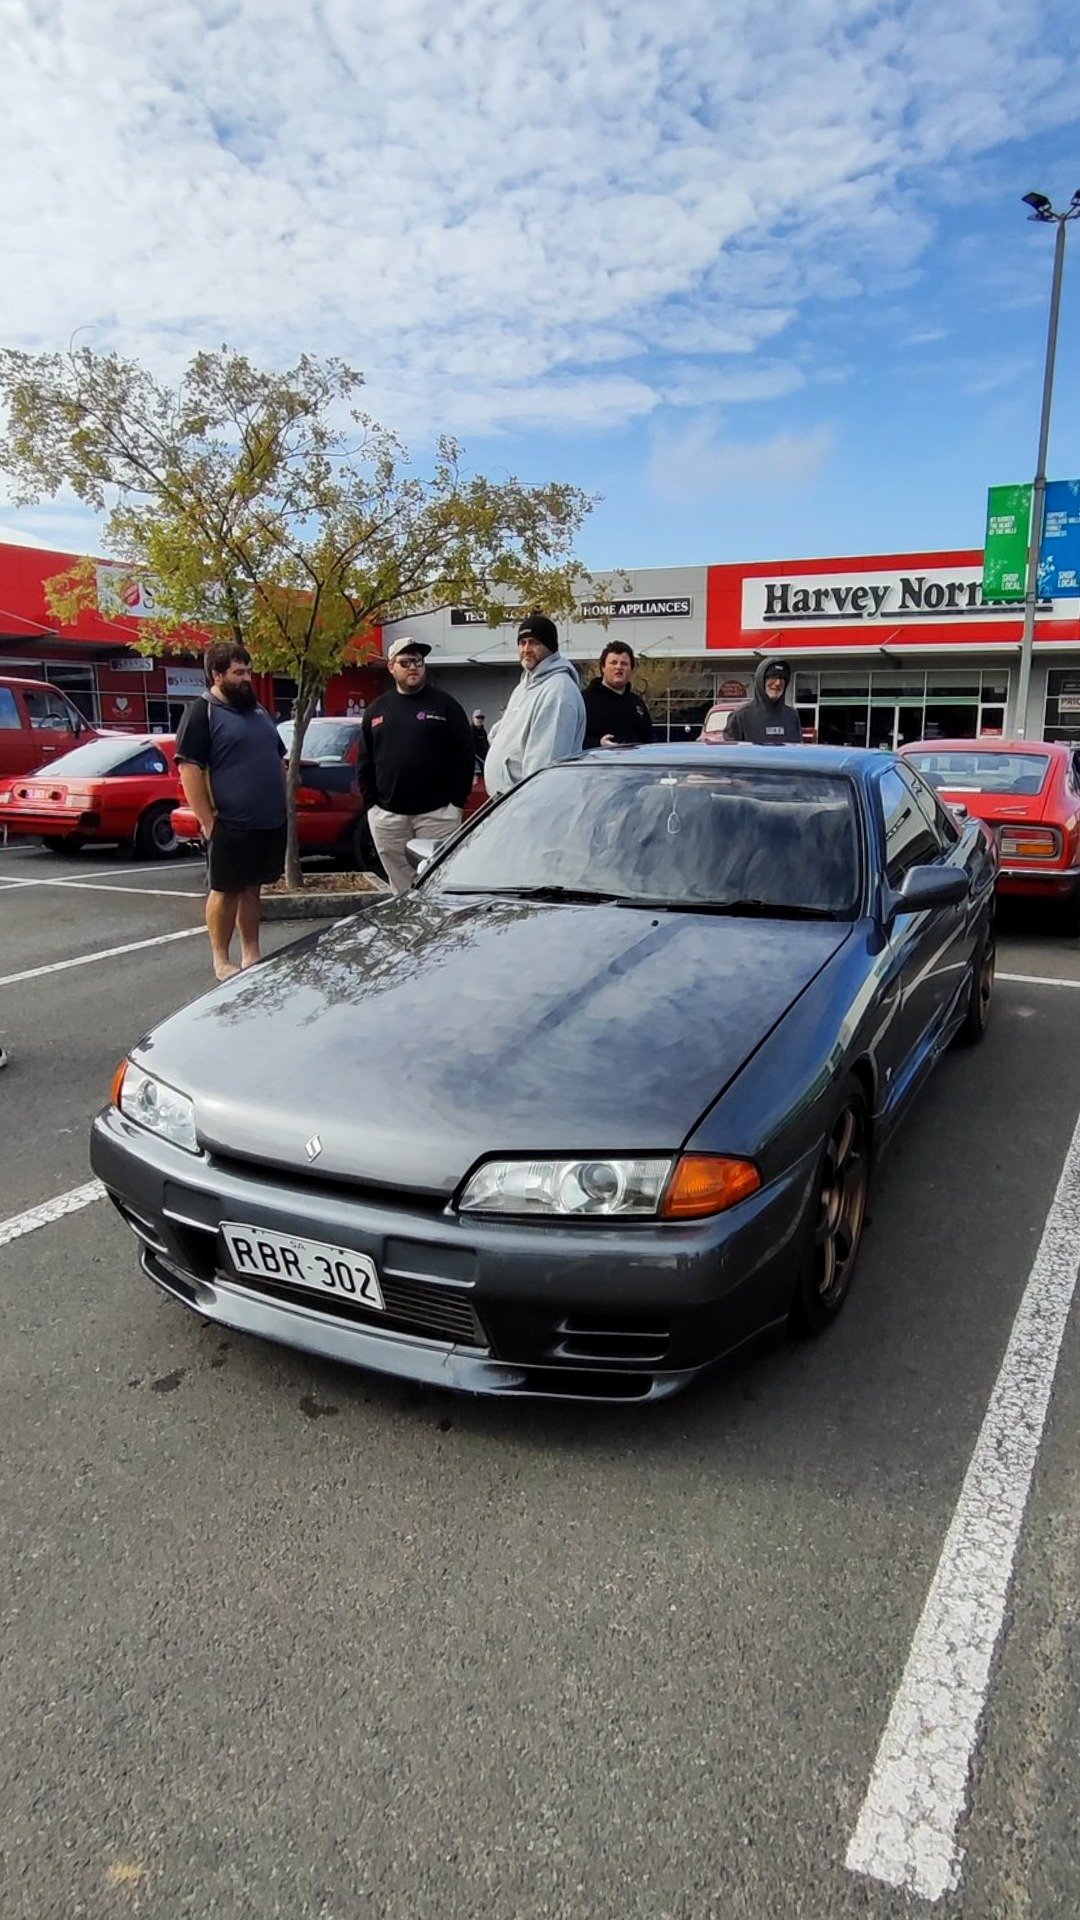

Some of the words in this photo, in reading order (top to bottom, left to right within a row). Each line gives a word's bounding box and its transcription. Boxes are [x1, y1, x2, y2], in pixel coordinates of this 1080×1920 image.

[583, 605, 616, 616] HOME
[619, 601, 688, 614] APPLIANCES
[764, 583, 891, 617] Harvey
[898, 577, 1053, 608] Norm
[231, 1237, 376, 1301] RBR-302
